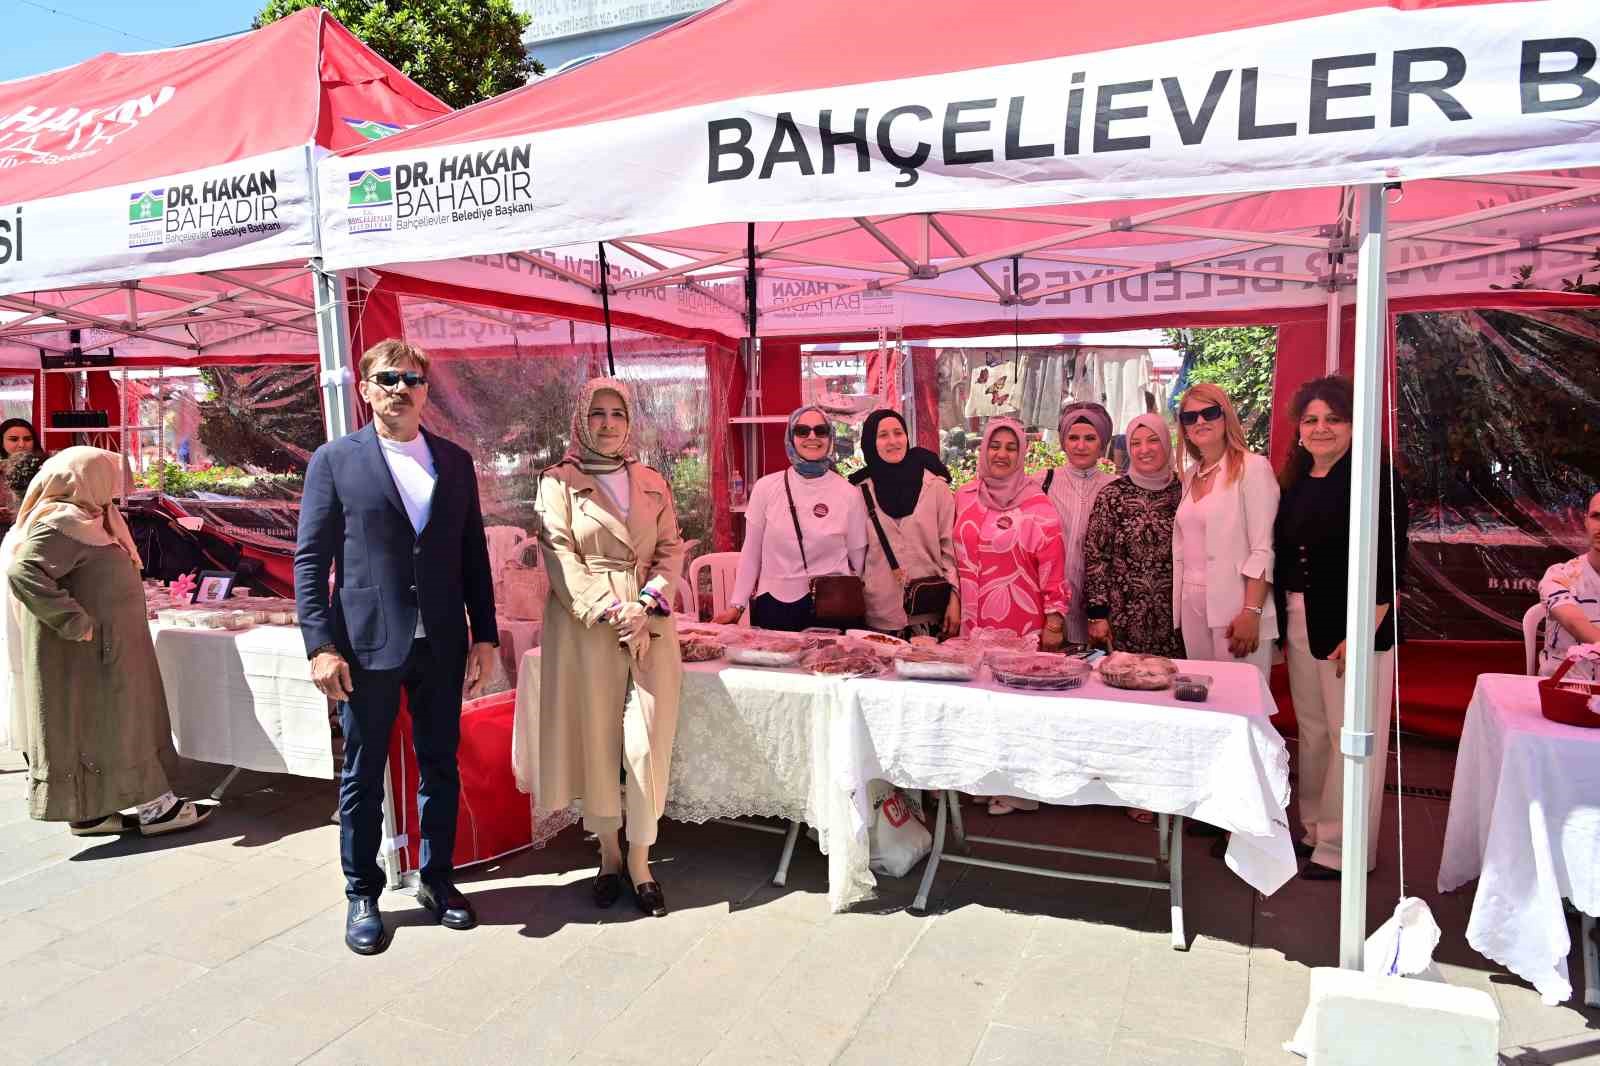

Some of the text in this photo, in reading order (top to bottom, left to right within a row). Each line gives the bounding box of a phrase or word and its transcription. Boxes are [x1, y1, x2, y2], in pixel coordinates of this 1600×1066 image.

[707, 46, 1473, 188] BAHÇELİEVLER
[395, 143, 532, 190] DR. HAKAN
[167, 169, 277, 208] DR. HAKAN
[396, 171, 532, 219] BAHADIR
[165, 195, 279, 233] BAHADIR
[211, 224, 248, 240] Belediye
[247, 221, 281, 236] Başkanı
[396, 212, 451, 231] Bahçelievler
[451, 208, 494, 224] Belediye
[494, 202, 534, 218] Başkanı
